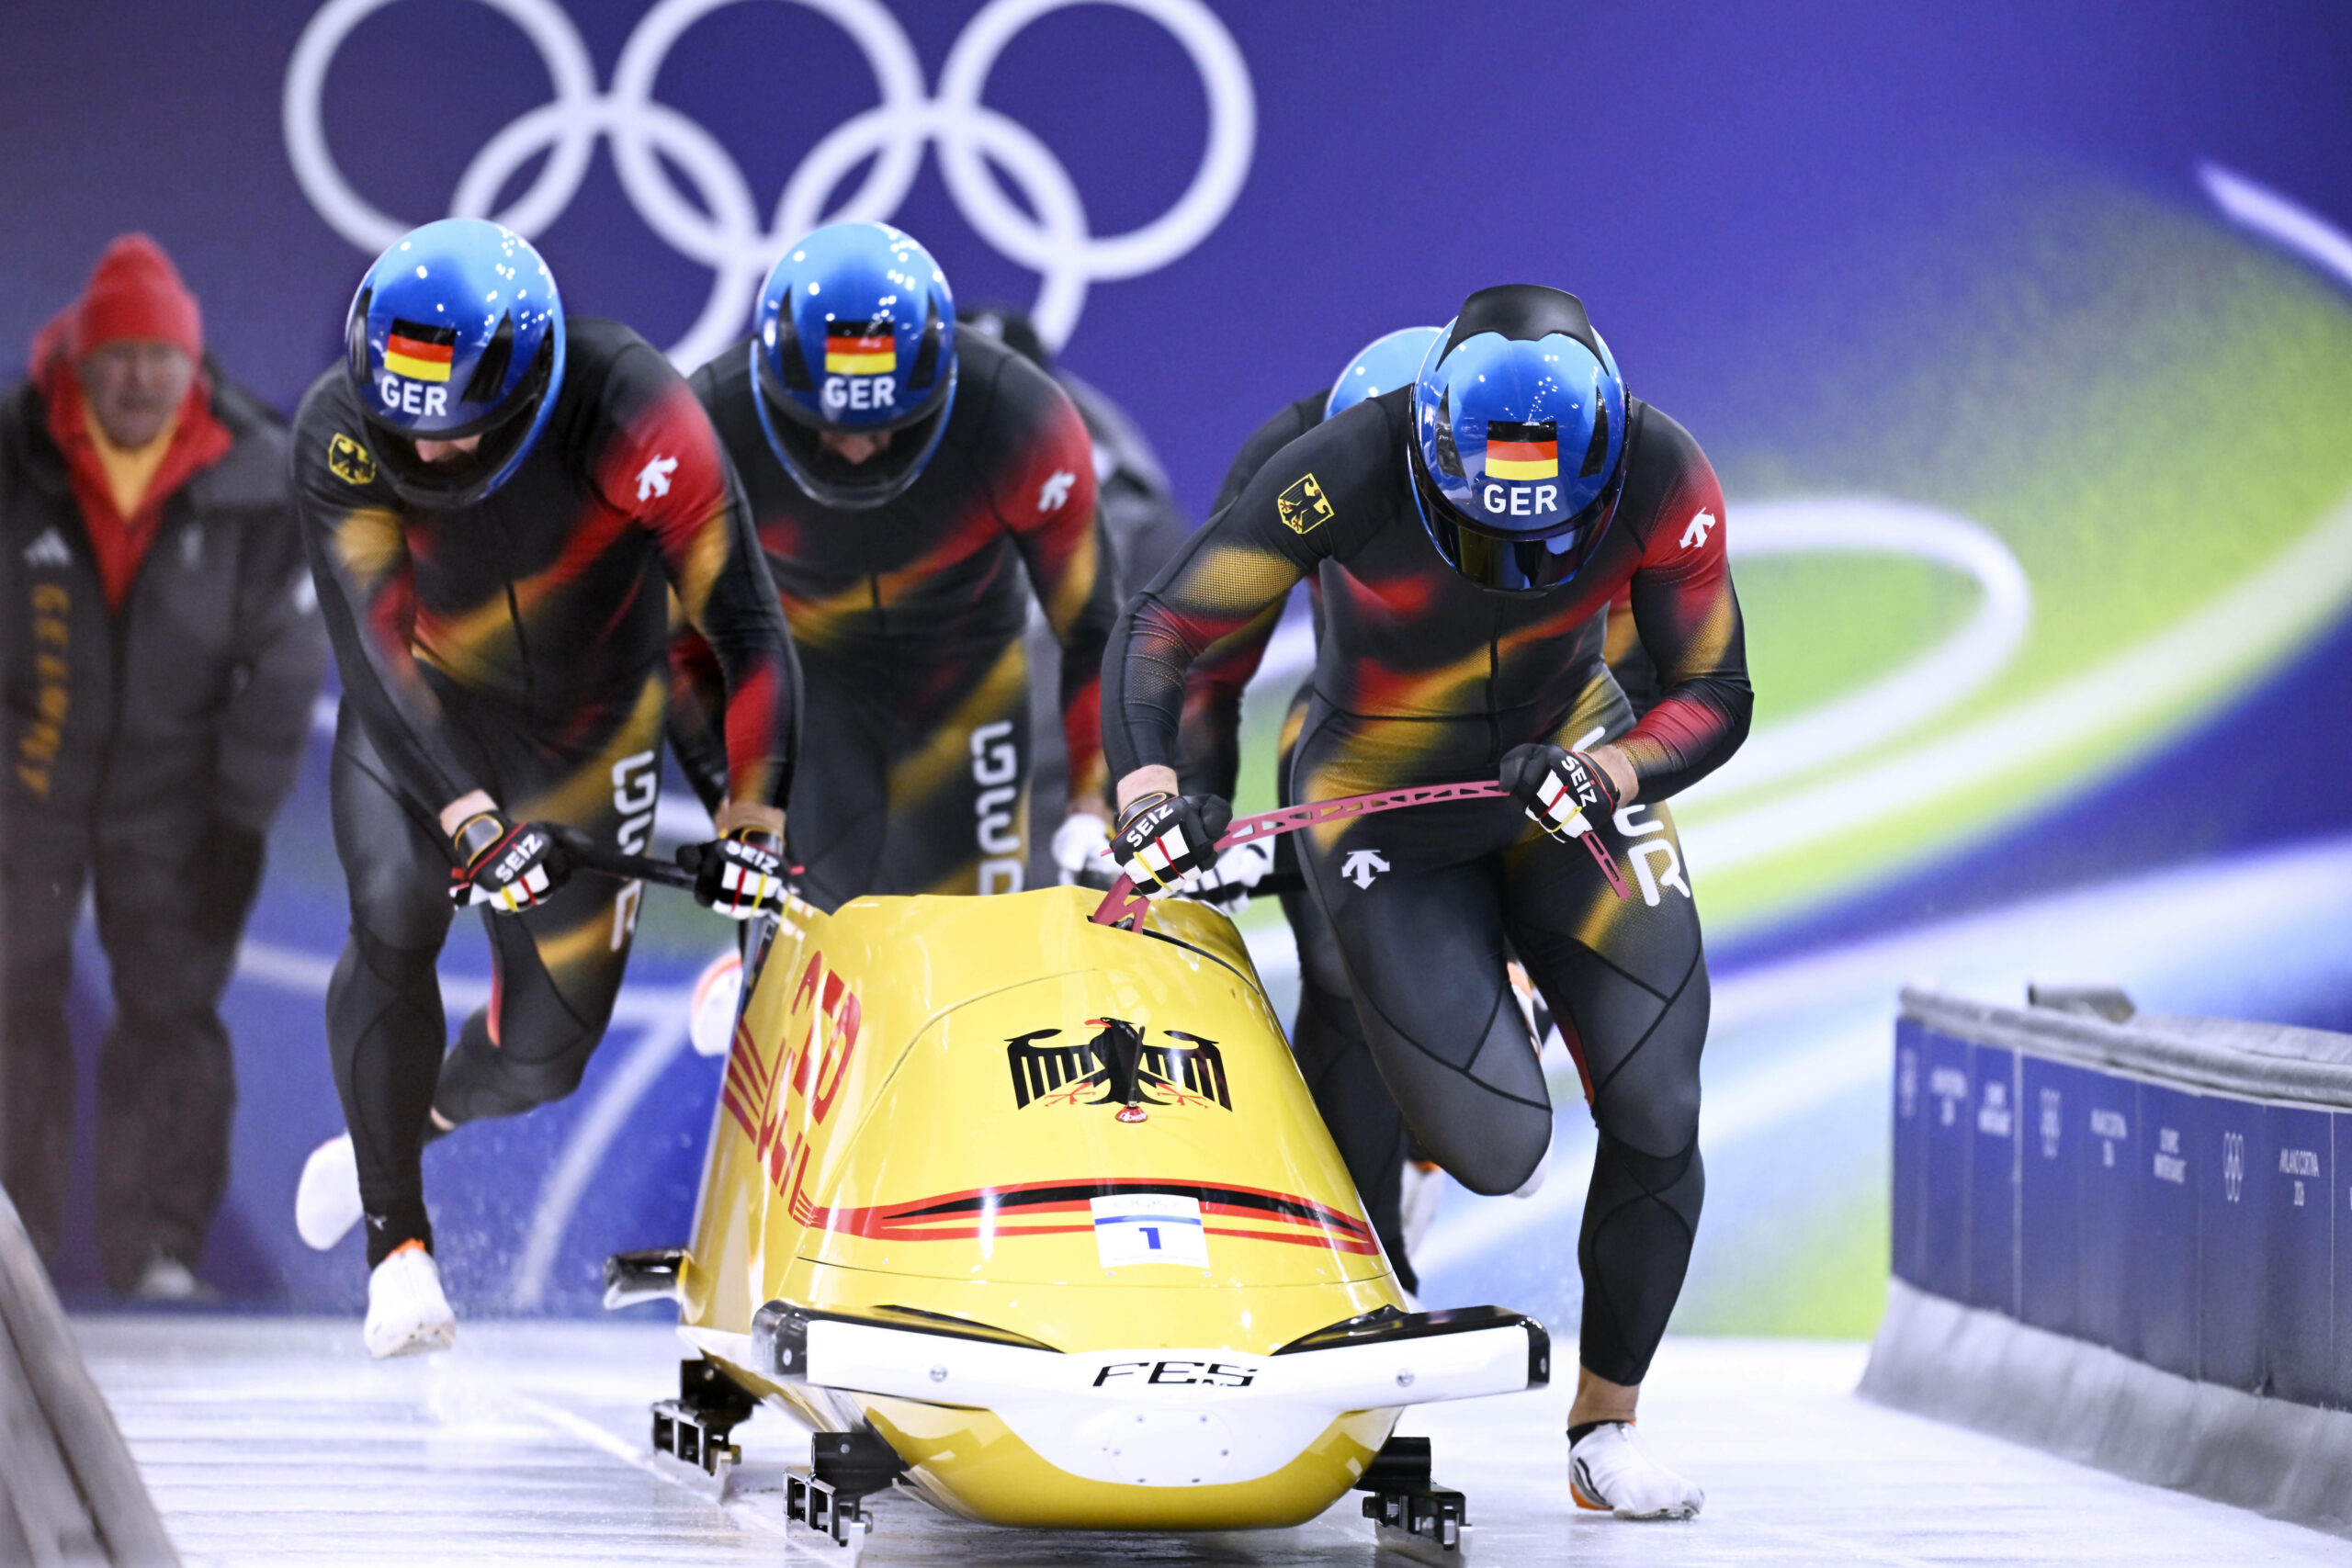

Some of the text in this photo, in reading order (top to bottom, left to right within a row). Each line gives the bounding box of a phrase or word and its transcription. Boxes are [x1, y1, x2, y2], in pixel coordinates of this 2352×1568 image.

[381, 375, 447, 416] GER
[825, 376, 896, 410] GER
[1484, 484, 1557, 515] GER
[1562, 755, 1598, 807] SEIZ
[1126, 804, 1174, 847] SEIZ
[495, 832, 543, 884] SEIZ
[1138, 1227, 1161, 1249] 1
[1092, 1361, 1259, 1387] FES
